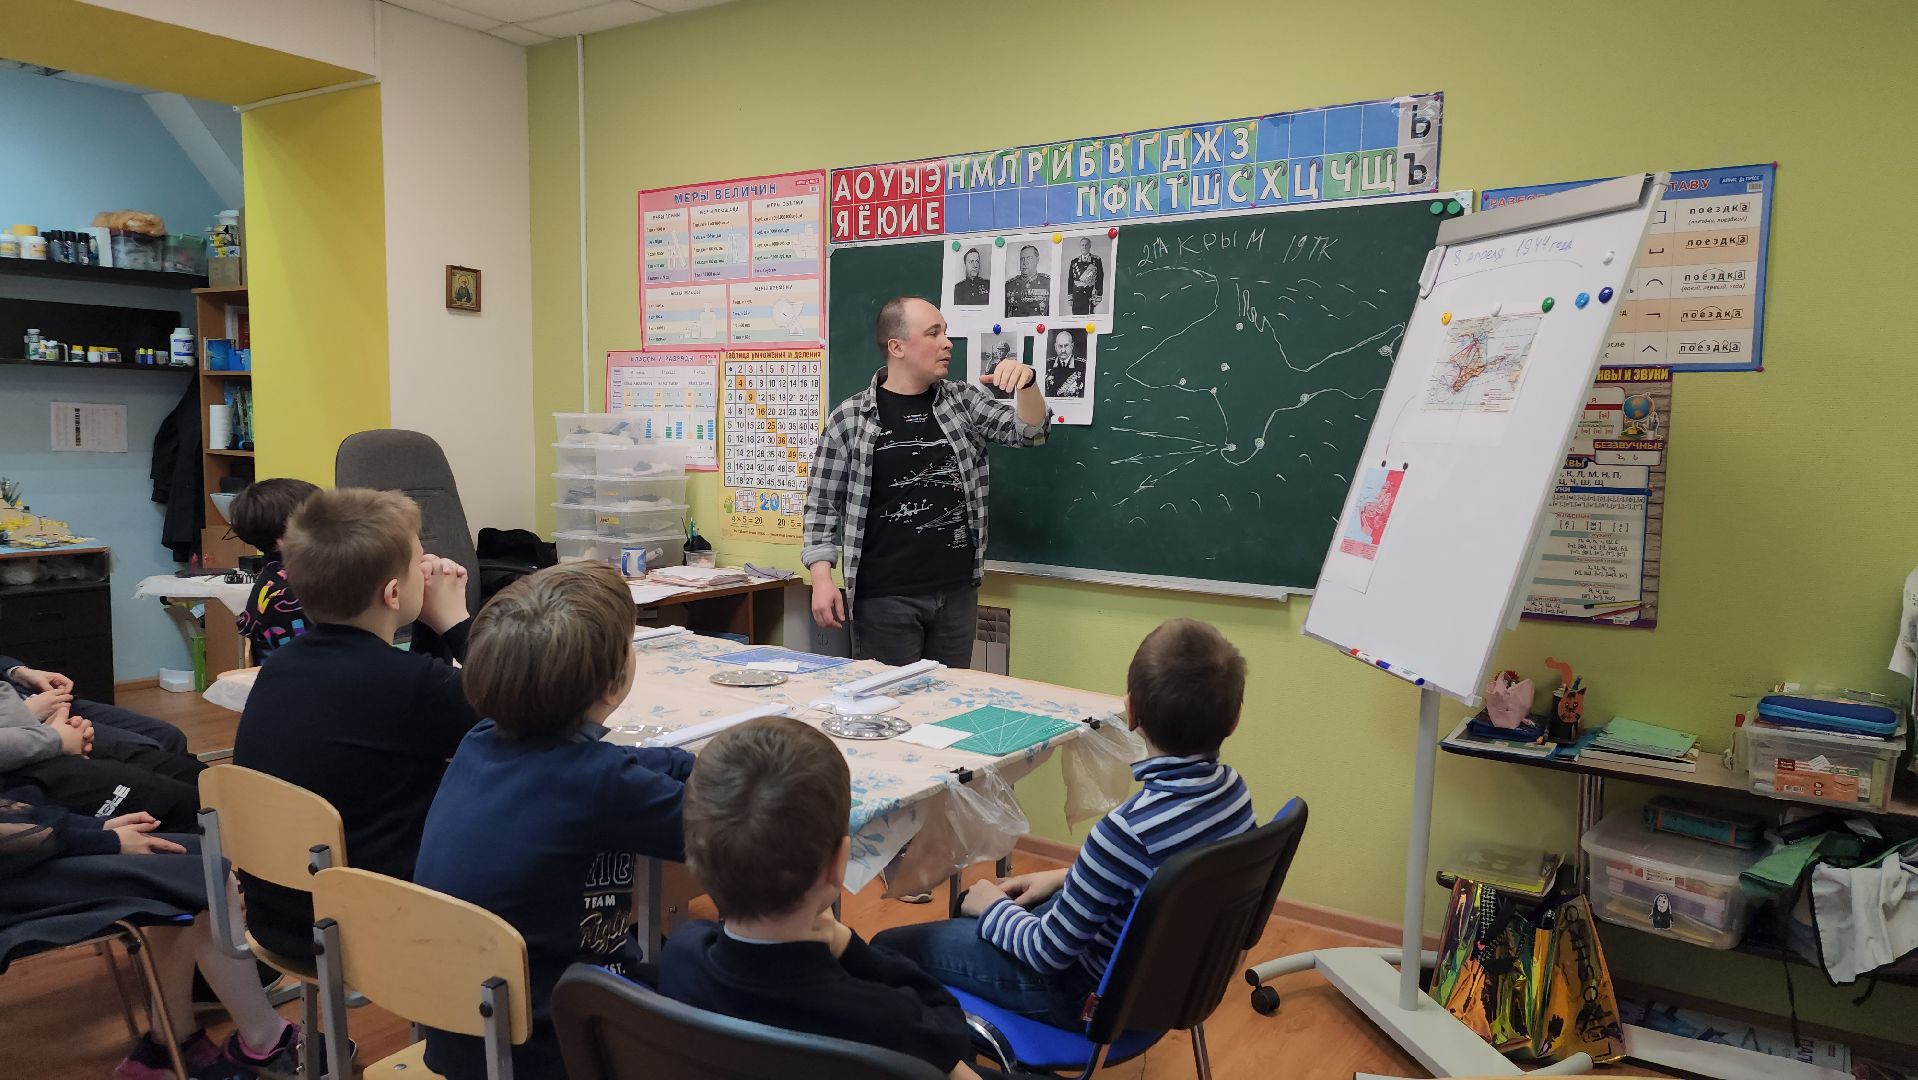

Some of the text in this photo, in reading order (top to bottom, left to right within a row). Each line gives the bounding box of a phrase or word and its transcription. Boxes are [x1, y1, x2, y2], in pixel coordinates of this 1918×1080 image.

[834, 175, 851, 201] А
[855, 172, 875, 199] О
[877, 169, 896, 197] У
[902, 166, 920, 194] Ы
[925, 164, 942, 192] Э
[948, 160, 965, 189] Н
[970, 158, 994, 188] М
[998, 154, 1016, 185] Л
[1028, 152, 1043, 182] Р
[1052, 146, 1072, 180] Й
[1079, 146, 1096, 176] Б
[1108, 142, 1125, 173] В
[1139, 138, 1153, 170] Г
[1162, 134, 1188, 171] Д
[1192, 131, 1221, 164] Ж
[1230, 127, 1249, 160] З
[674, 184, 777, 203] МЕРЫ ВЕЛИЧИН
[836, 210, 848, 237] Я
[858, 205, 871, 236] Ё
[878, 206, 898, 234] Ю
[902, 204, 918, 232] И
[926, 202, 940, 230] Е
[1077, 186, 1096, 216] П
[1103, 184, 1126, 214] Ф
[1135, 180, 1154, 212] К
[1167, 178, 1185, 208] Т
[1192, 174, 1220, 205] Ш
[1228, 171, 1248, 203] С
[1260, 167, 1282, 200] Х
[1295, 162, 1318, 199] Ц
[1331, 160, 1352, 194] Ч
[1361, 154, 1395, 191] Щ
[1178, 227, 1266, 254] КРЫМ
[726, 352, 749, 360] Таблица
[752, 351, 786, 360] умножения
[738, 365, 817, 373] 2 3 4 5 6 7 8 9
[1633, 368, 1668, 380] ЗВУКИ
[728, 421, 732, 429] 5
[778, 422, 785, 430] 30
[799, 423, 807, 431] 40
[810, 423, 818, 431] 45
[736, 435, 743, 443] 12
[767, 436, 775, 444] 30
[799, 437, 807, 445] 48
[810, 437, 818, 445] 54
[1595, 441, 1663, 450] БЕЗЗВУЧНЫЕ
[736, 449, 743, 457] 14
[767, 450, 775, 458] 35
[788, 451, 796, 459] 49
[727, 462, 731, 470] 8
[736, 463, 743, 471] 16
[746, 463, 754, 471] 24
[767, 464, 775, 472] 40
[777, 464, 785, 472] 48
[756, 478, 764, 486] 36
[584, 895, 616, 909] TEAM
